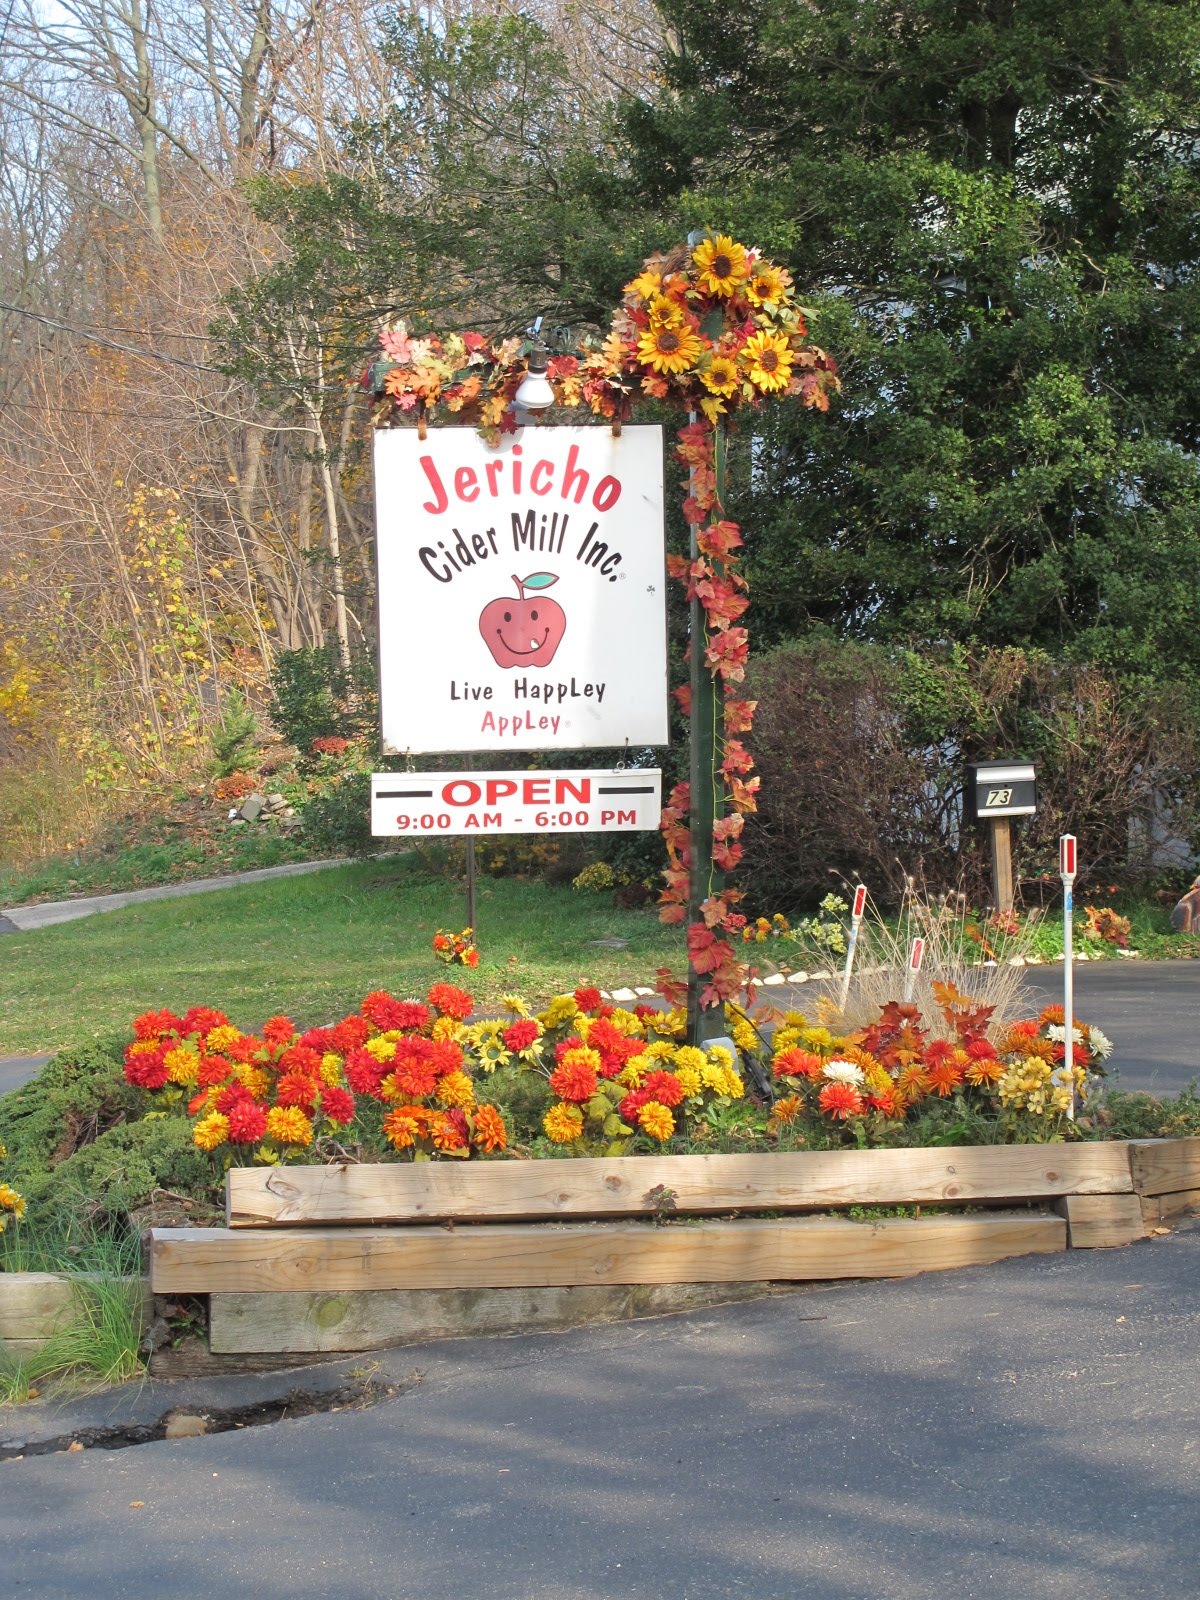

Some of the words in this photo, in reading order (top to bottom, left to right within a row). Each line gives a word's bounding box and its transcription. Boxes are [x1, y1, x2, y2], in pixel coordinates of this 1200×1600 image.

[419, 444, 622, 515] Jericho
[418, 527, 499, 583] Cider
[511, 509, 569, 554] Mill
[576, 522, 623, 583] Inc.
[450, 681, 493, 701] Live
[514, 677, 606, 704] HappLey
[481, 710, 561, 736] AppLey
[441, 778, 591, 807] OPEN
[989, 791, 1010, 805] 73
[396, 813, 451, 830] 9:00
[464, 812, 502, 828] AM
[534, 810, 589, 827] 6:00
[601, 810, 637, 825] PM
